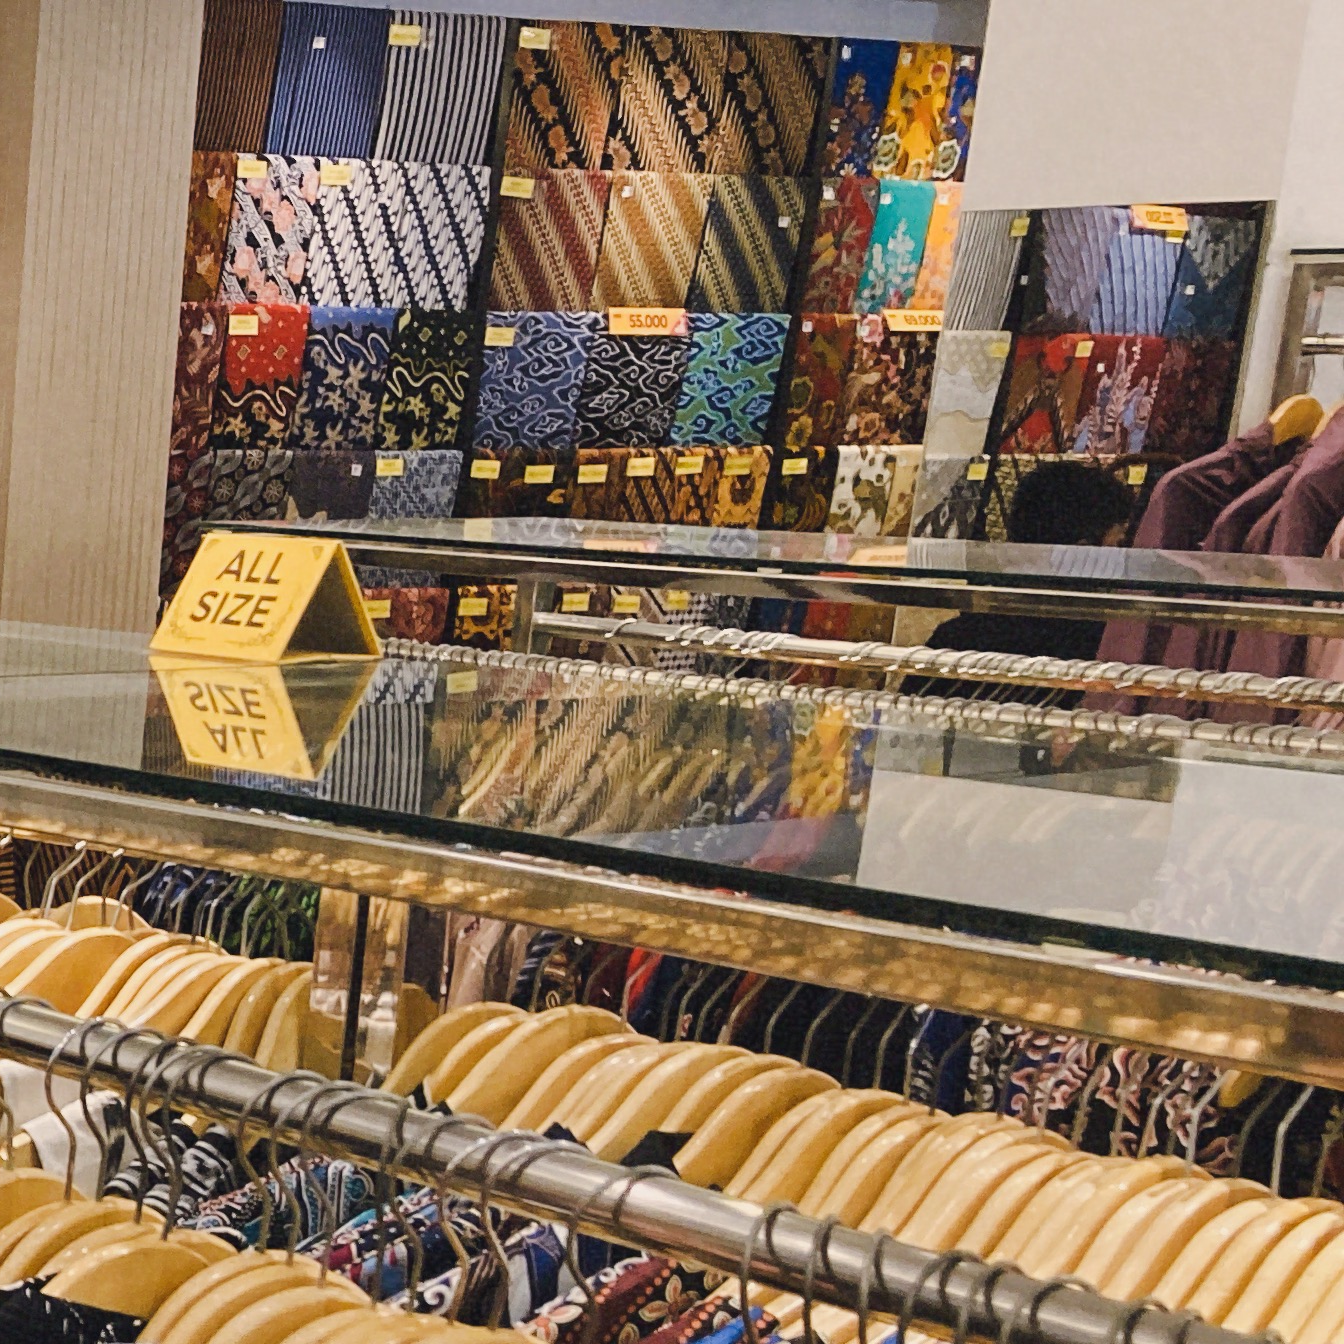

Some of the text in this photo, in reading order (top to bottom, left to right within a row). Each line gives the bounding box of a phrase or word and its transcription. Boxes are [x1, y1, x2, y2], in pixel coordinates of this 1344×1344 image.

[628, 313, 668, 329] 55.000
[215, 549, 284, 585] ALL
[189, 590, 278, 628] SIZE
